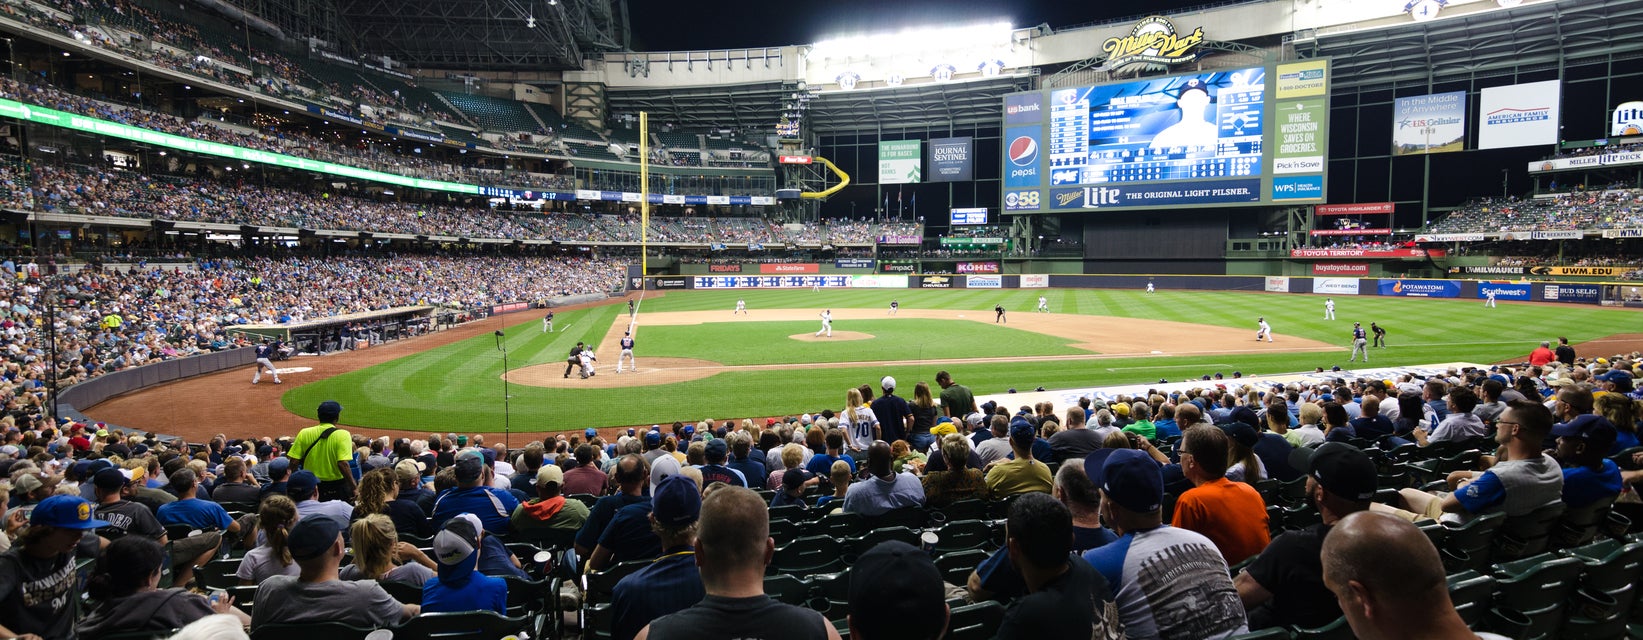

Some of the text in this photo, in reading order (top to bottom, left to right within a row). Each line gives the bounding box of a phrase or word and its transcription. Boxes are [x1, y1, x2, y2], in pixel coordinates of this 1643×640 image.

[1103, 27, 1204, 60] Miller Park
[1428, 95, 1458, 104] Middle
[1412, 103, 1457, 114] Anywhere
[1288, 112, 1311, 122] WHERE
[1488, 112, 1522, 120] AMERICAN
[1427, 117, 1461, 127] Cellular
[1280, 122, 1318, 133] WISCONSIN
[1283, 132, 1315, 143] SAVES ON
[935, 146, 968, 155] JOURNAL
[1280, 142, 1317, 154] GROCERIES.
[934, 153, 968, 161] SENTINEL
[1570, 158, 1597, 166] MILLER
[1012, 167, 1036, 178] pepsi
[1275, 184, 1294, 192] WPS
[1019, 191, 1040, 206] 58
[1056, 187, 1120, 208] Miller Lite
[1144, 190, 1183, 199] ORIGINAL
[1184, 189, 1211, 198] LIGHT
[1212, 188, 1251, 197] PILSNER.
[1620, 229, 1642, 237] WTMJ
[890, 264, 914, 272] impact
[1315, 264, 1366, 272] buyatoyota.com
